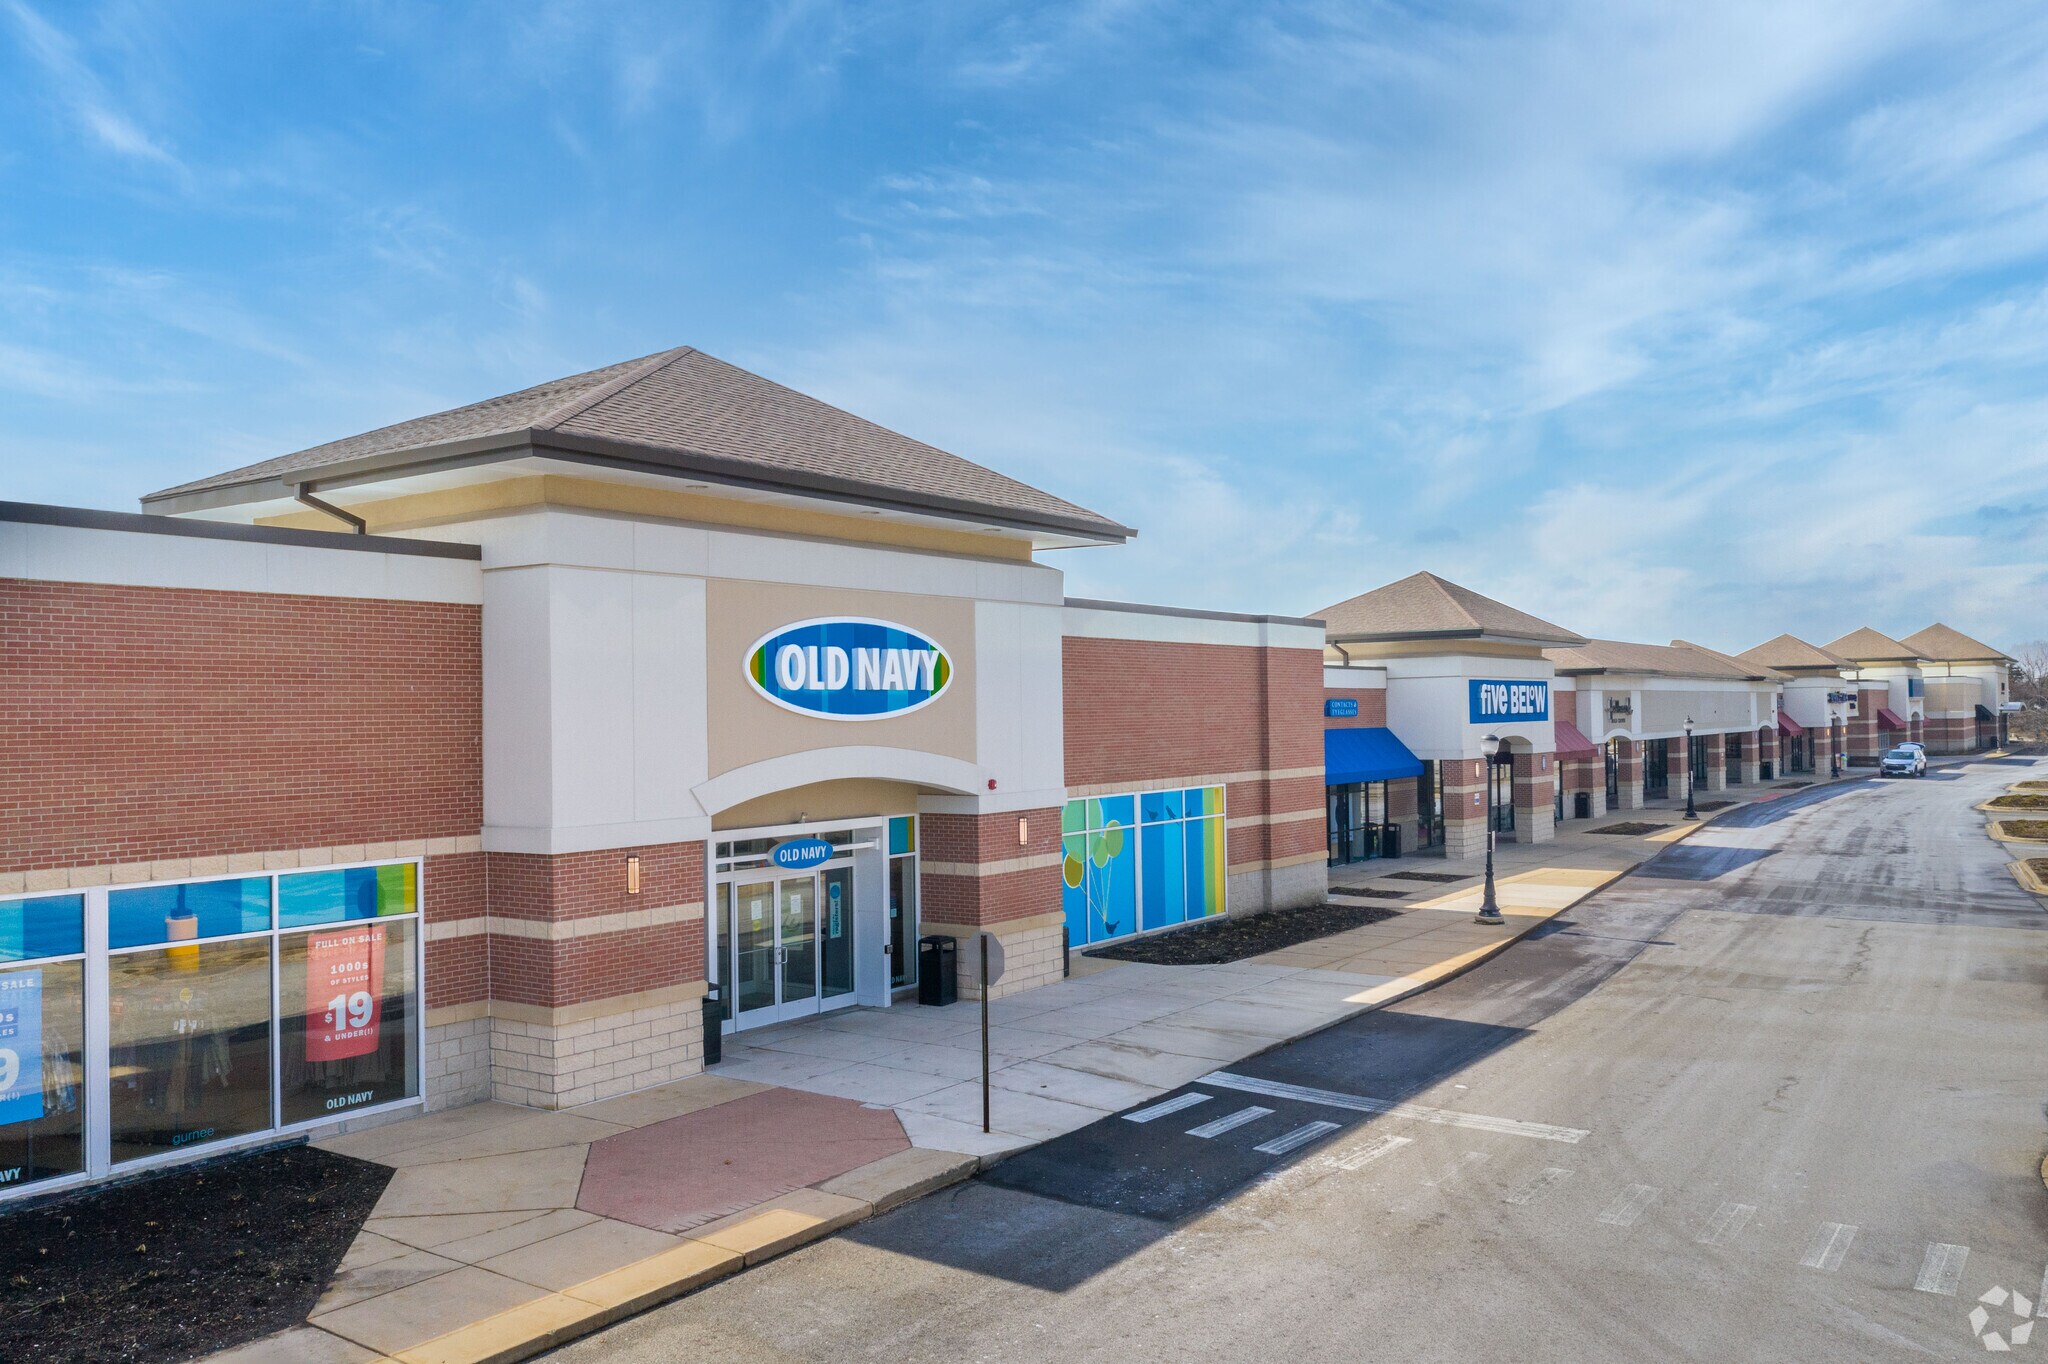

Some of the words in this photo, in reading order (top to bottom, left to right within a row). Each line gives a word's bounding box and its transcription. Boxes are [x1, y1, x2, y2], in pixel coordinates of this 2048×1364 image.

[777, 643, 850, 691] OLD
[855, 647, 940, 691] NAVY
[1480, 683, 1508, 715] five
[1510, 685, 1547, 714] BELOW
[779, 848, 800, 863] OLD
[801, 845, 827, 860] NAVY
[315, 939, 340, 949] FULL
[342, 936, 355, 945] ON
[358, 933, 382, 943] SALE
[330, 961, 369, 975] 1000s
[1, 977, 35, 991] SALE
[330, 978, 341, 986] OF
[342, 975, 369, 984] STYLES
[324, 991, 374, 1032] $19
[324, 1034, 332, 1042] &
[335, 1027, 374, 1041] UNDER(!)
[326, 1096, 346, 1110] OLD
[347, 1089, 374, 1105] NAVY
[172, 1127, 215, 1146] gurnee
[0, 1166, 22, 1183] AVY
